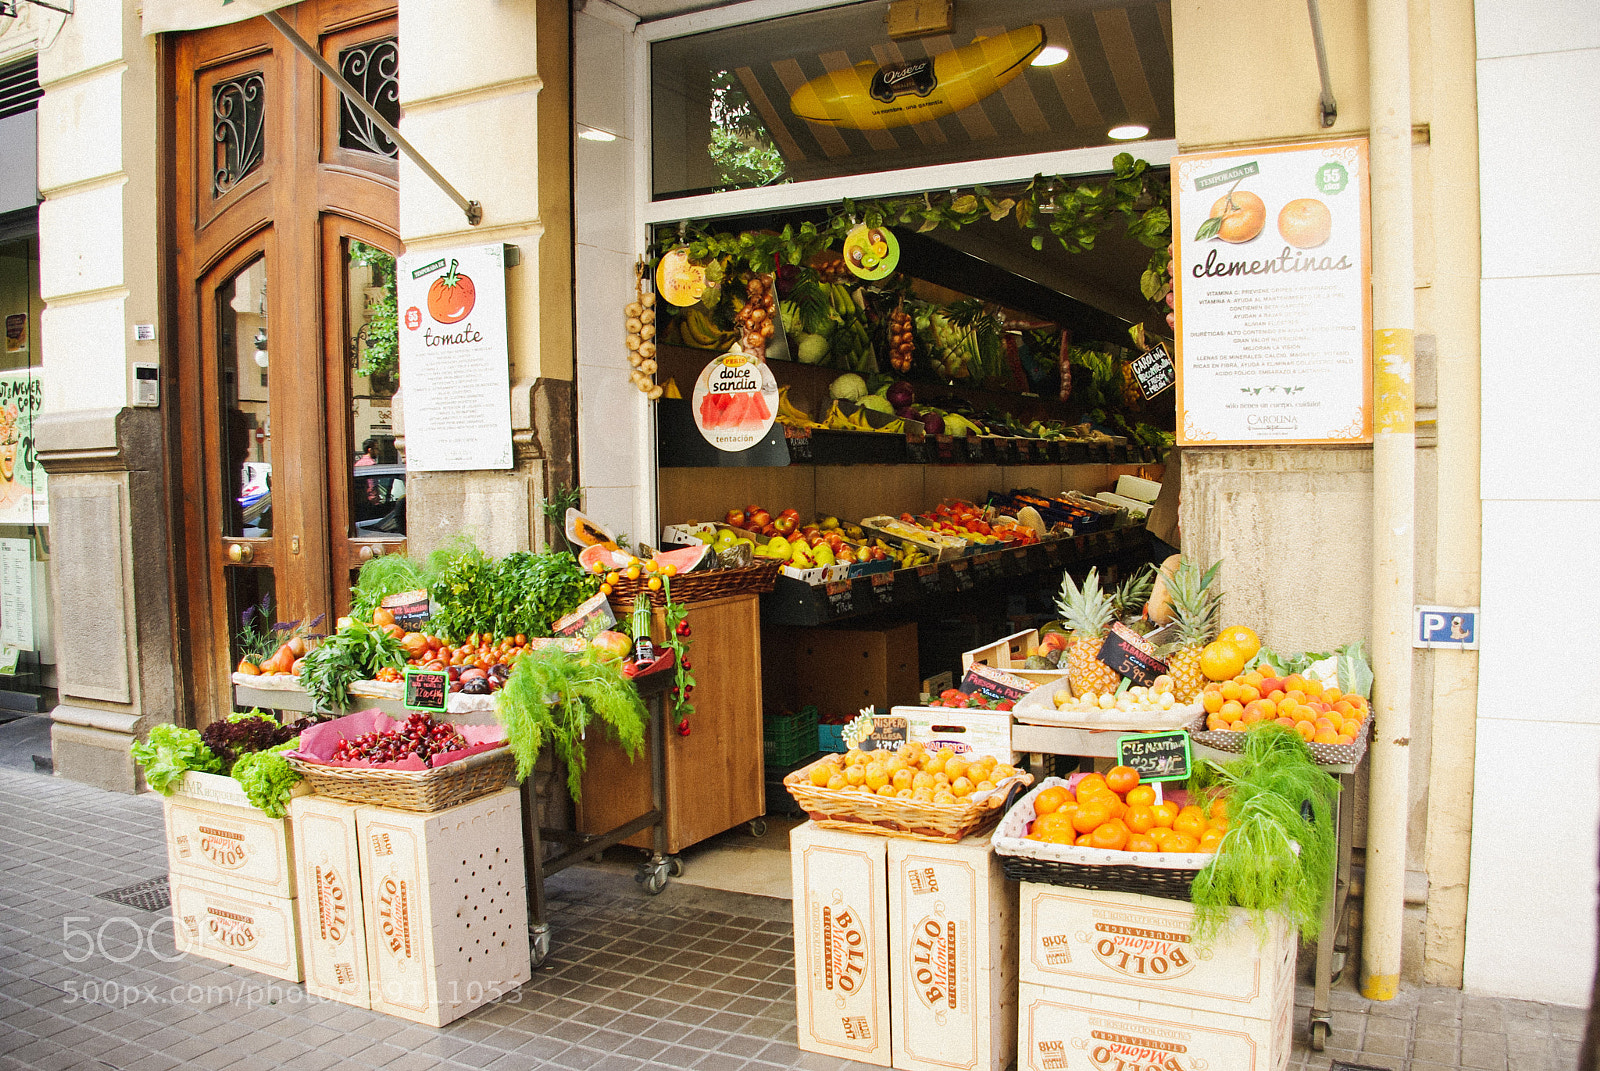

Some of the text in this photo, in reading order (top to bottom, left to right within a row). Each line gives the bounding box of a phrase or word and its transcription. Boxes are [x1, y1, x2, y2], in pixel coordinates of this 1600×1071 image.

[883, 62, 928, 84] Orsero
[1200, 165, 1256, 188] TEMPORADA DE
[1322, 168, 1341, 184] 55
[1192, 246, 1352, 278] clementinas
[408, 310, 418, 321] 55
[423, 322, 483, 347] tomate
[720, 367, 751, 380] dolce
[17, 394, 42, 413] COPY
[1247, 414, 1298, 425] CAROLINA
[1423, 613, 1446, 639] P
[1118, 641, 1167, 674] ALBARICOQUE
[922, 740, 973, 753] VALENCIA
[201, 838, 245, 865] BOLLO
[925, 867, 939, 893] 2018
[324, 870, 346, 941] BOLLO
[380, 879, 402, 952] BOLLO
[393, 895, 404, 943] Melones
[823, 907, 831, 955] ETIQUETA
[210, 919, 255, 947] BOLLO
[1042, 934, 1068, 948] 2018
[1096, 923, 1190, 943] ETIQUETA NEGRA
[1112, 935, 1173, 955] Melones
[832, 924, 848, 977] Melones
[835, 911, 864, 992] BOLLO
[914, 920, 944, 1004] BOLLO
[1097, 939, 1189, 974] BOLLO
[931, 936, 947, 991] Melones
[948, 957, 956, 1007] ETIQUETA
[841, 1016, 856, 1040] 2017
[1038, 1041, 1064, 1052] 2018
[1093, 1030, 1185, 1053] ETIQUETA NEGRA
[1108, 1043, 1169, 1064] Melones
